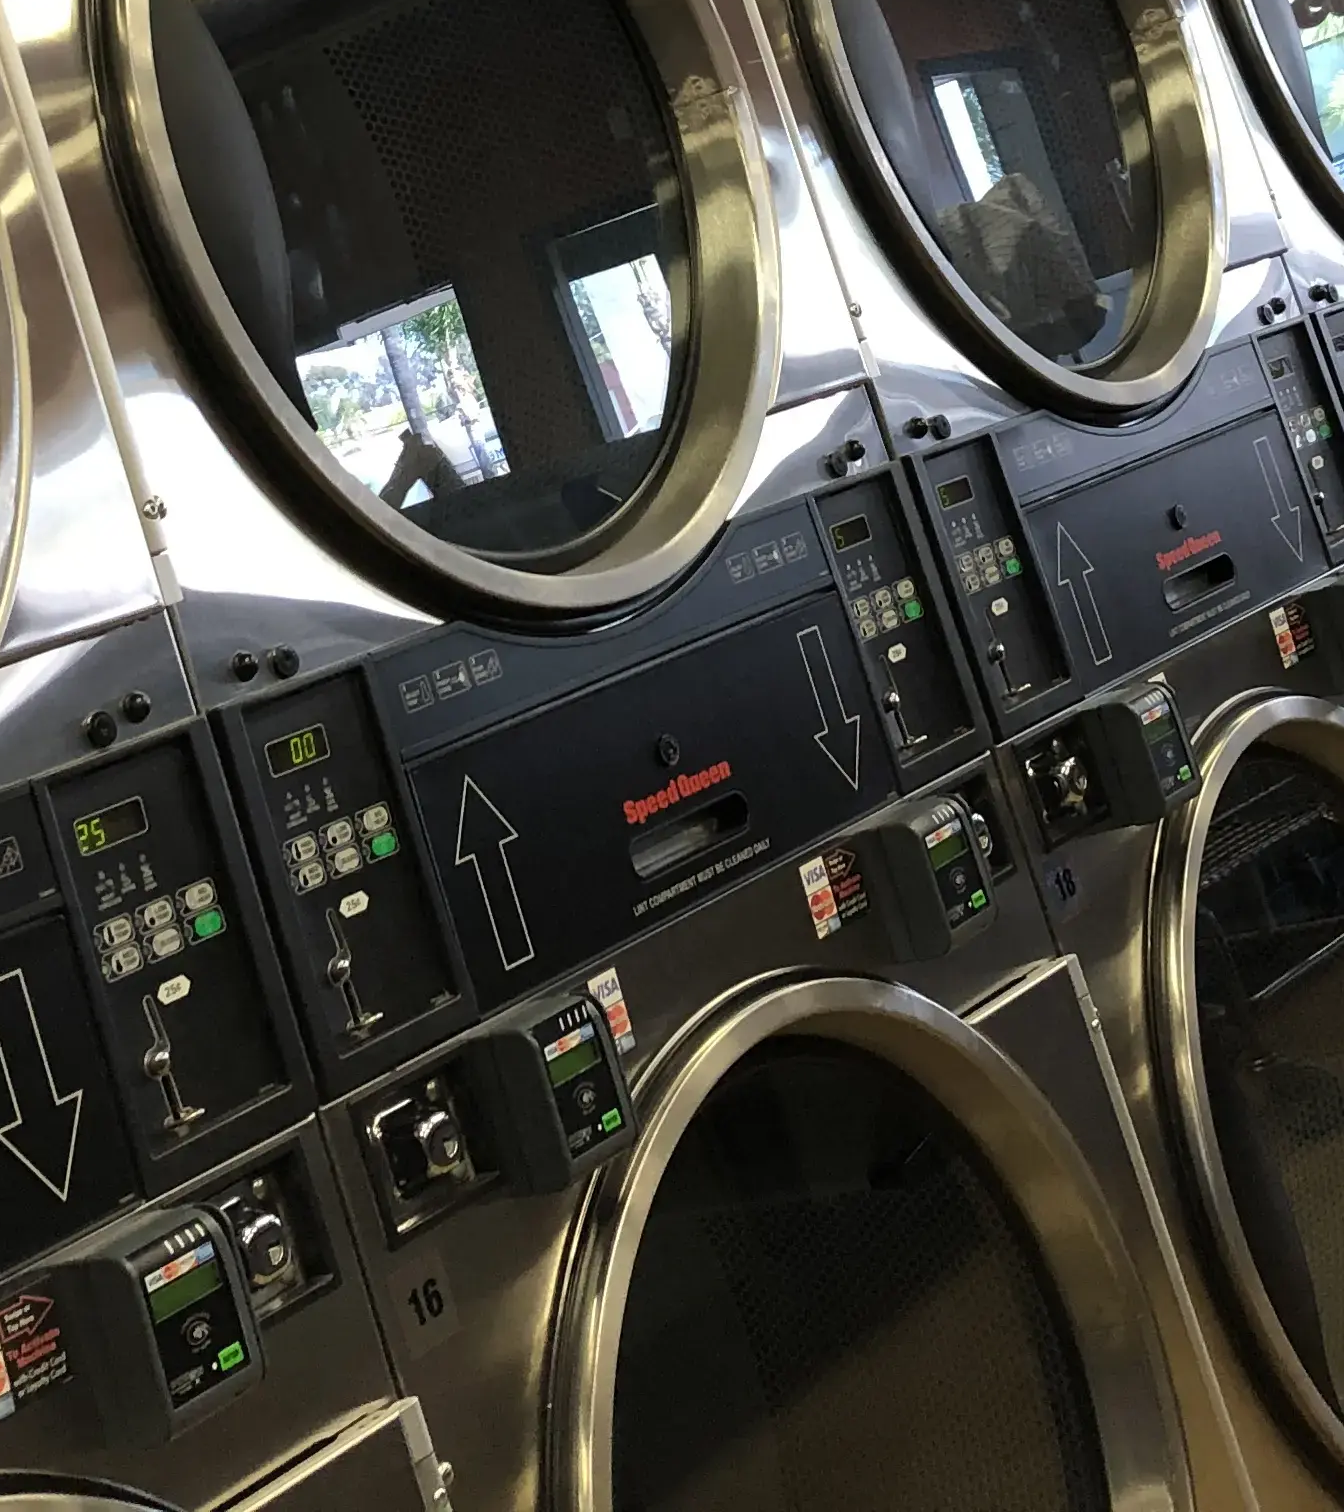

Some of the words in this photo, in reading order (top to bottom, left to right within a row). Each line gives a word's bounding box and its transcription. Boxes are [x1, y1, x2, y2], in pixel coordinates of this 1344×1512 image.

[289, 732, 316, 765] 00
[622, 779, 680, 825] Speed
[677, 760, 732, 798] Queen
[76, 817, 106, 852] 25
[804, 865, 826, 886] VISA
[1055, 869, 1075, 901] 18
[408, 1278, 443, 1325] 16
